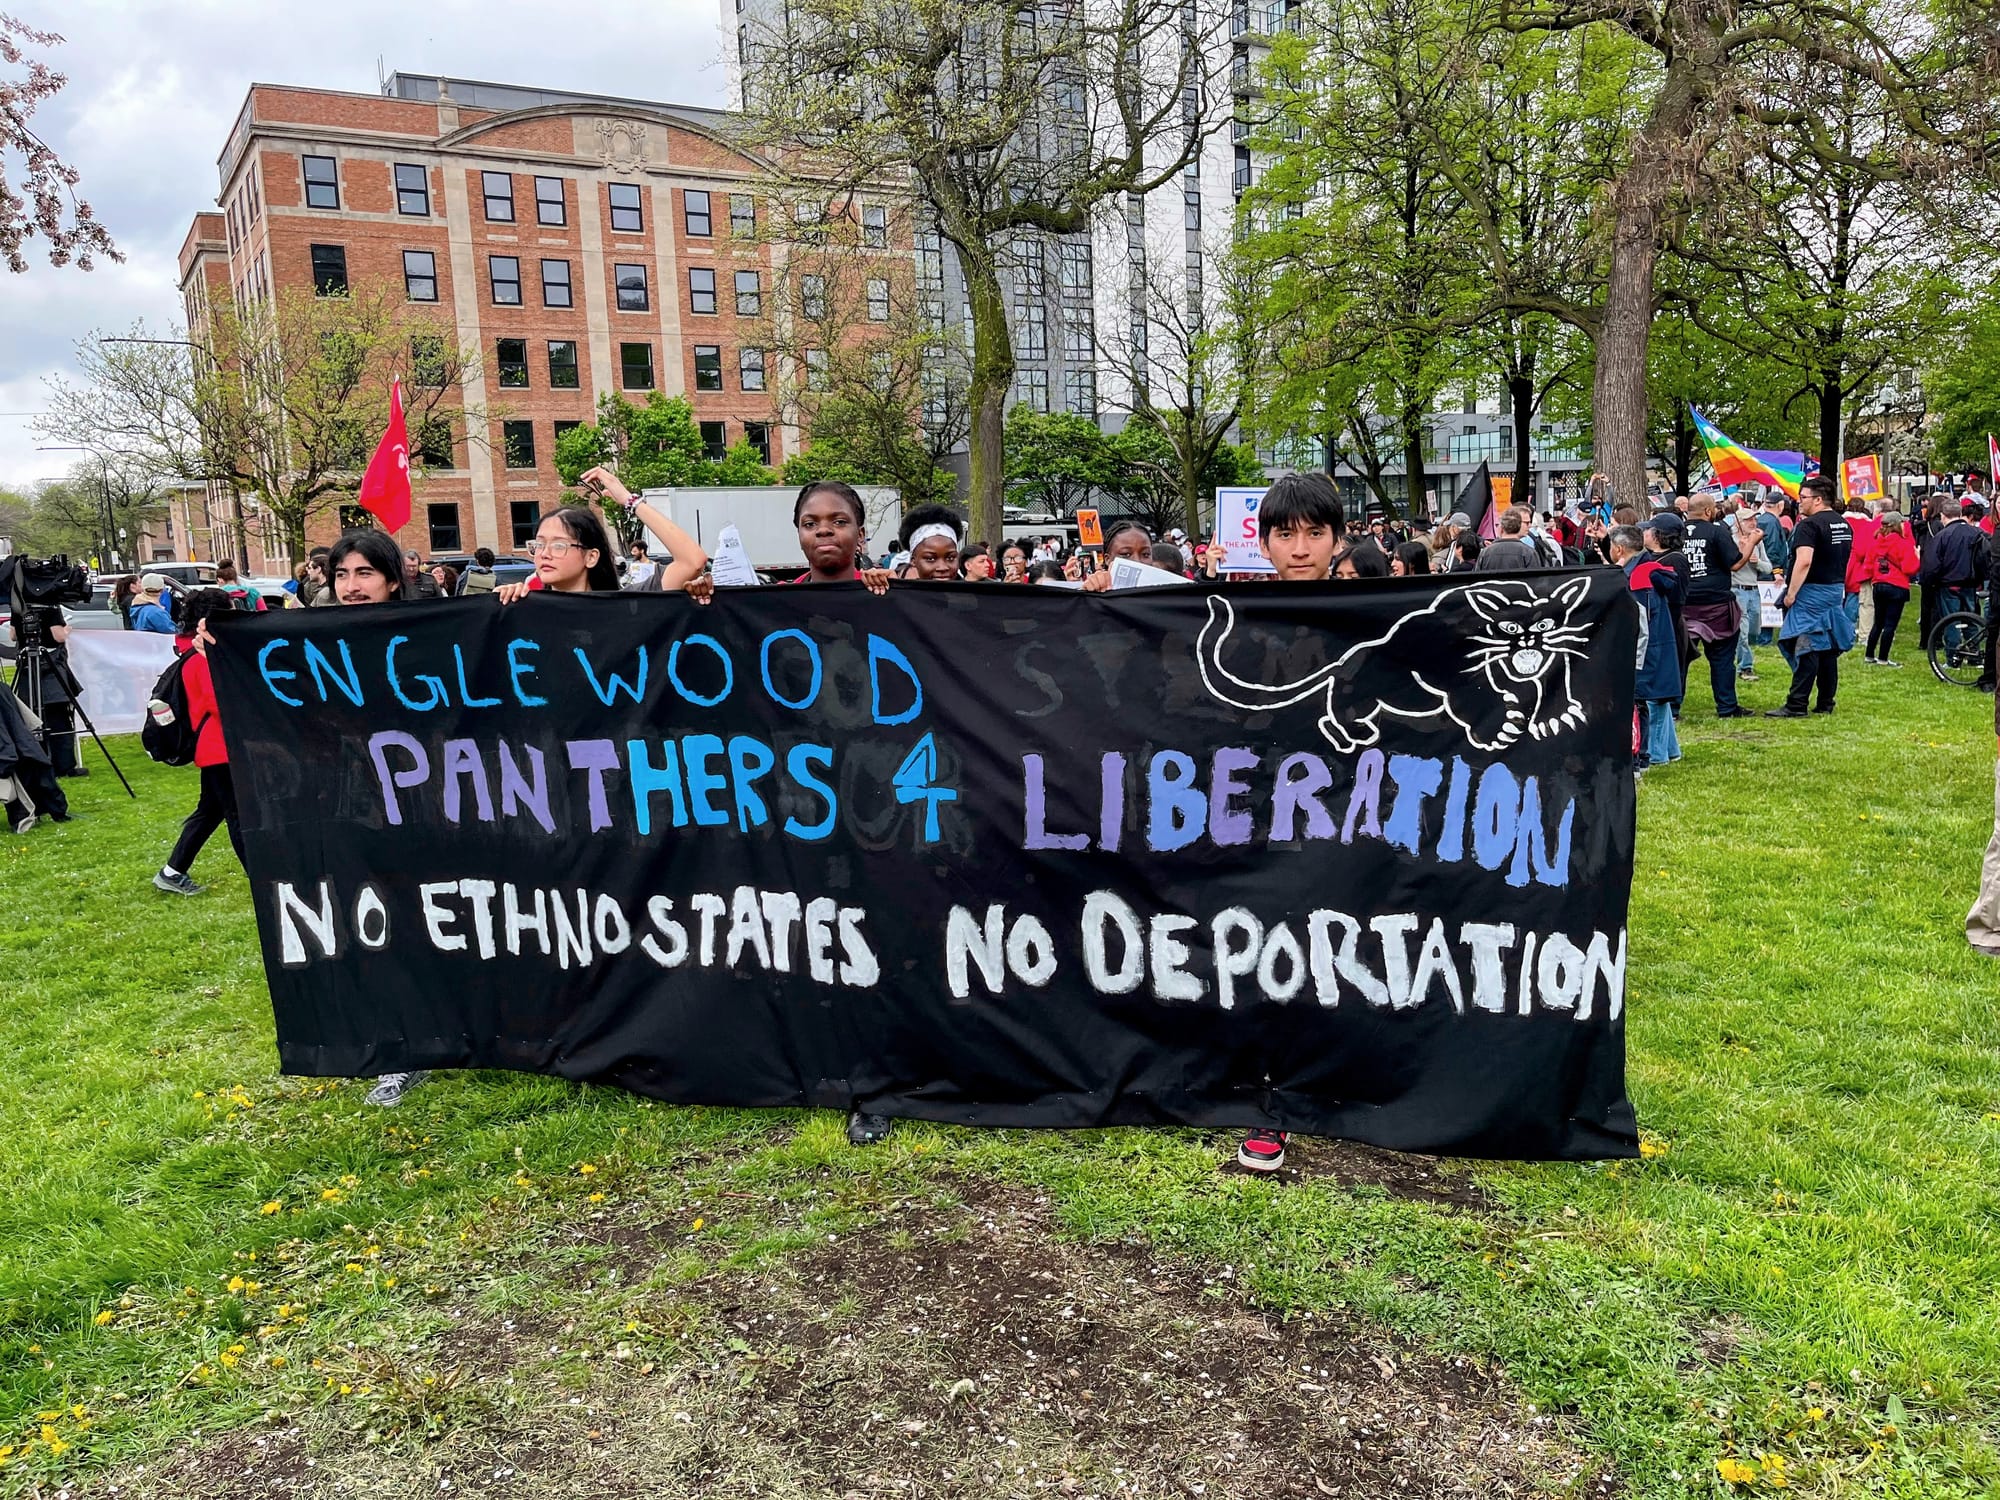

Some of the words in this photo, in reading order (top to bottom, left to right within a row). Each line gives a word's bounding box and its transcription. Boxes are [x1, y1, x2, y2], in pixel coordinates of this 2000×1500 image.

[1683, 539, 1706, 547] THING
[257, 628, 924, 727] ENGLEWOOD
[367, 729, 838, 841] PANTHERS
[891, 731, 958, 843] 4
[1022, 746, 1577, 890] LIBERATION
[277, 880, 387, 964] NO
[945, 903, 1058, 999] NO
[1080, 889, 1627, 1020] DEPORTATION
